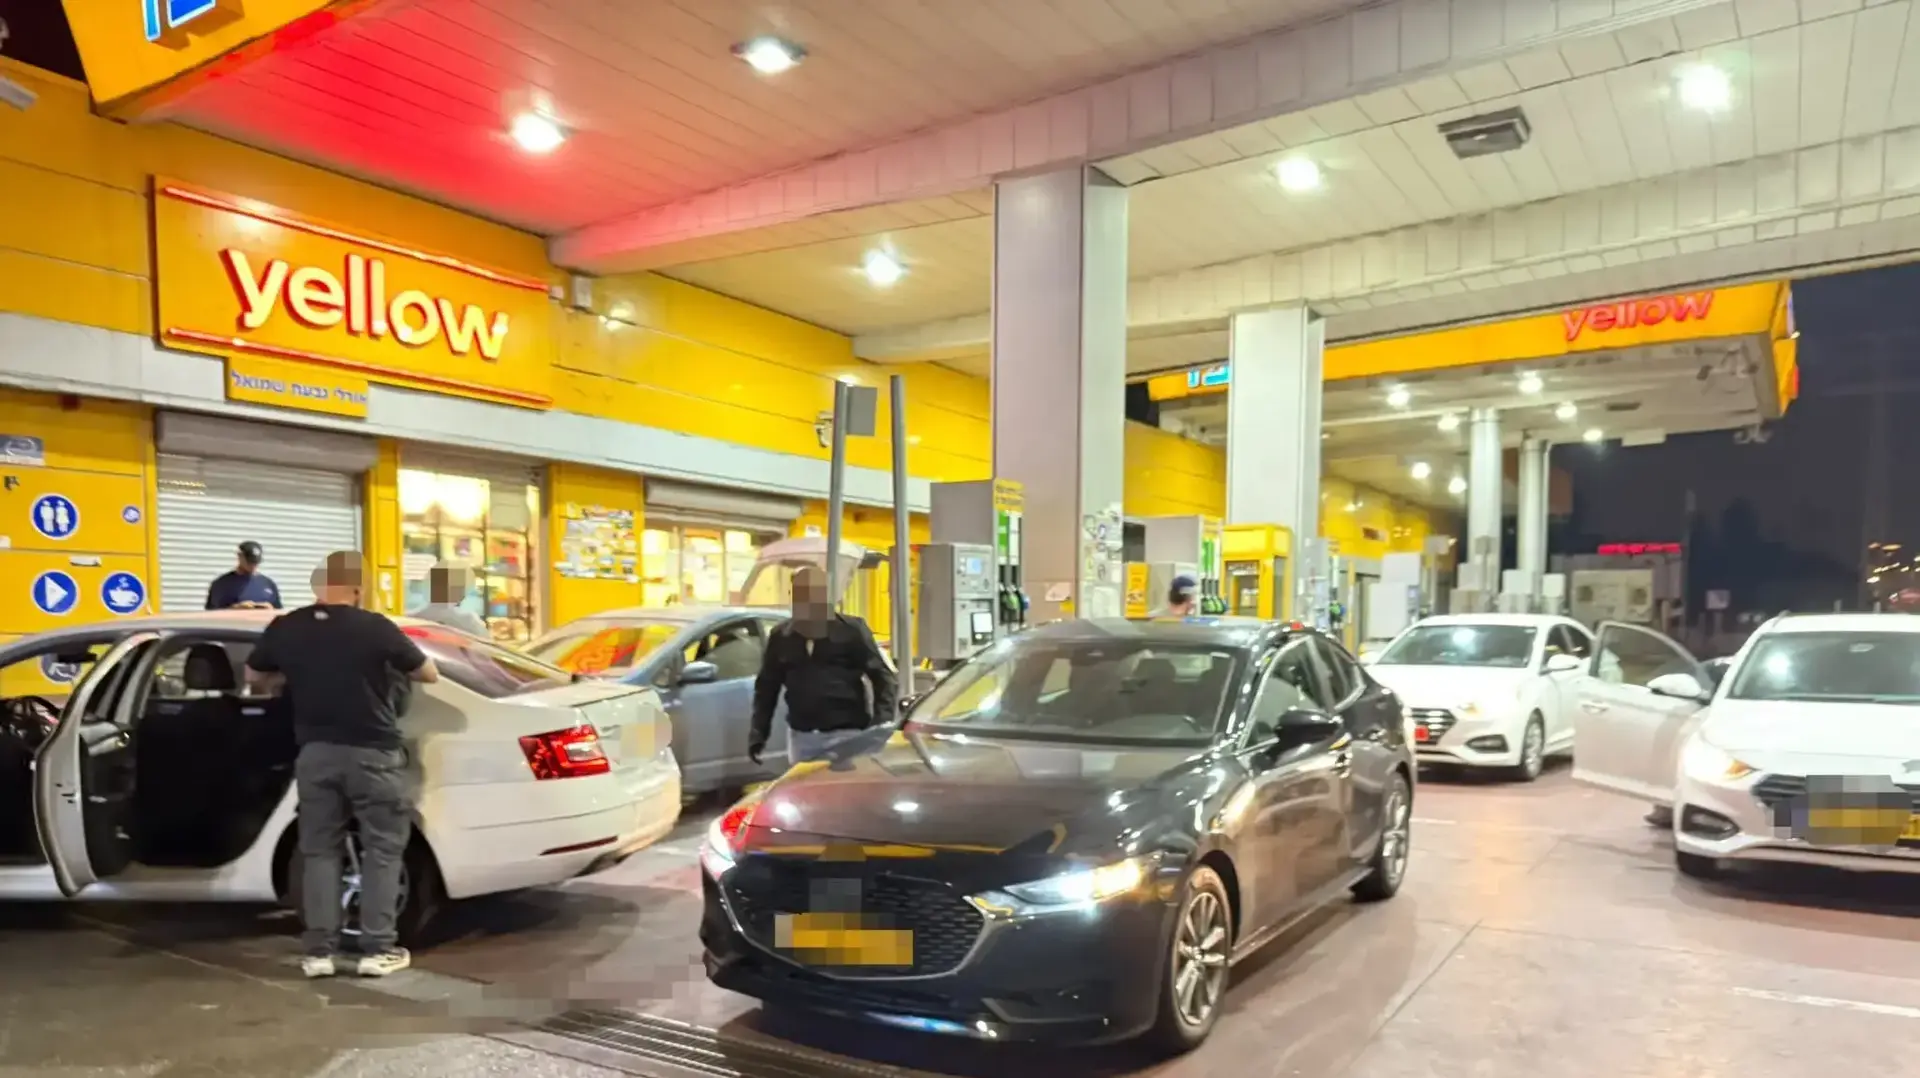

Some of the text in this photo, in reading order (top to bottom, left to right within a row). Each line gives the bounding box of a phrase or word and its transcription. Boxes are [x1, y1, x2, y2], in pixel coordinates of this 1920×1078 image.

[219, 249, 508, 360] yellow
[1563, 291, 1714, 341] yellow
[231, 369, 284, 393] שמואל
